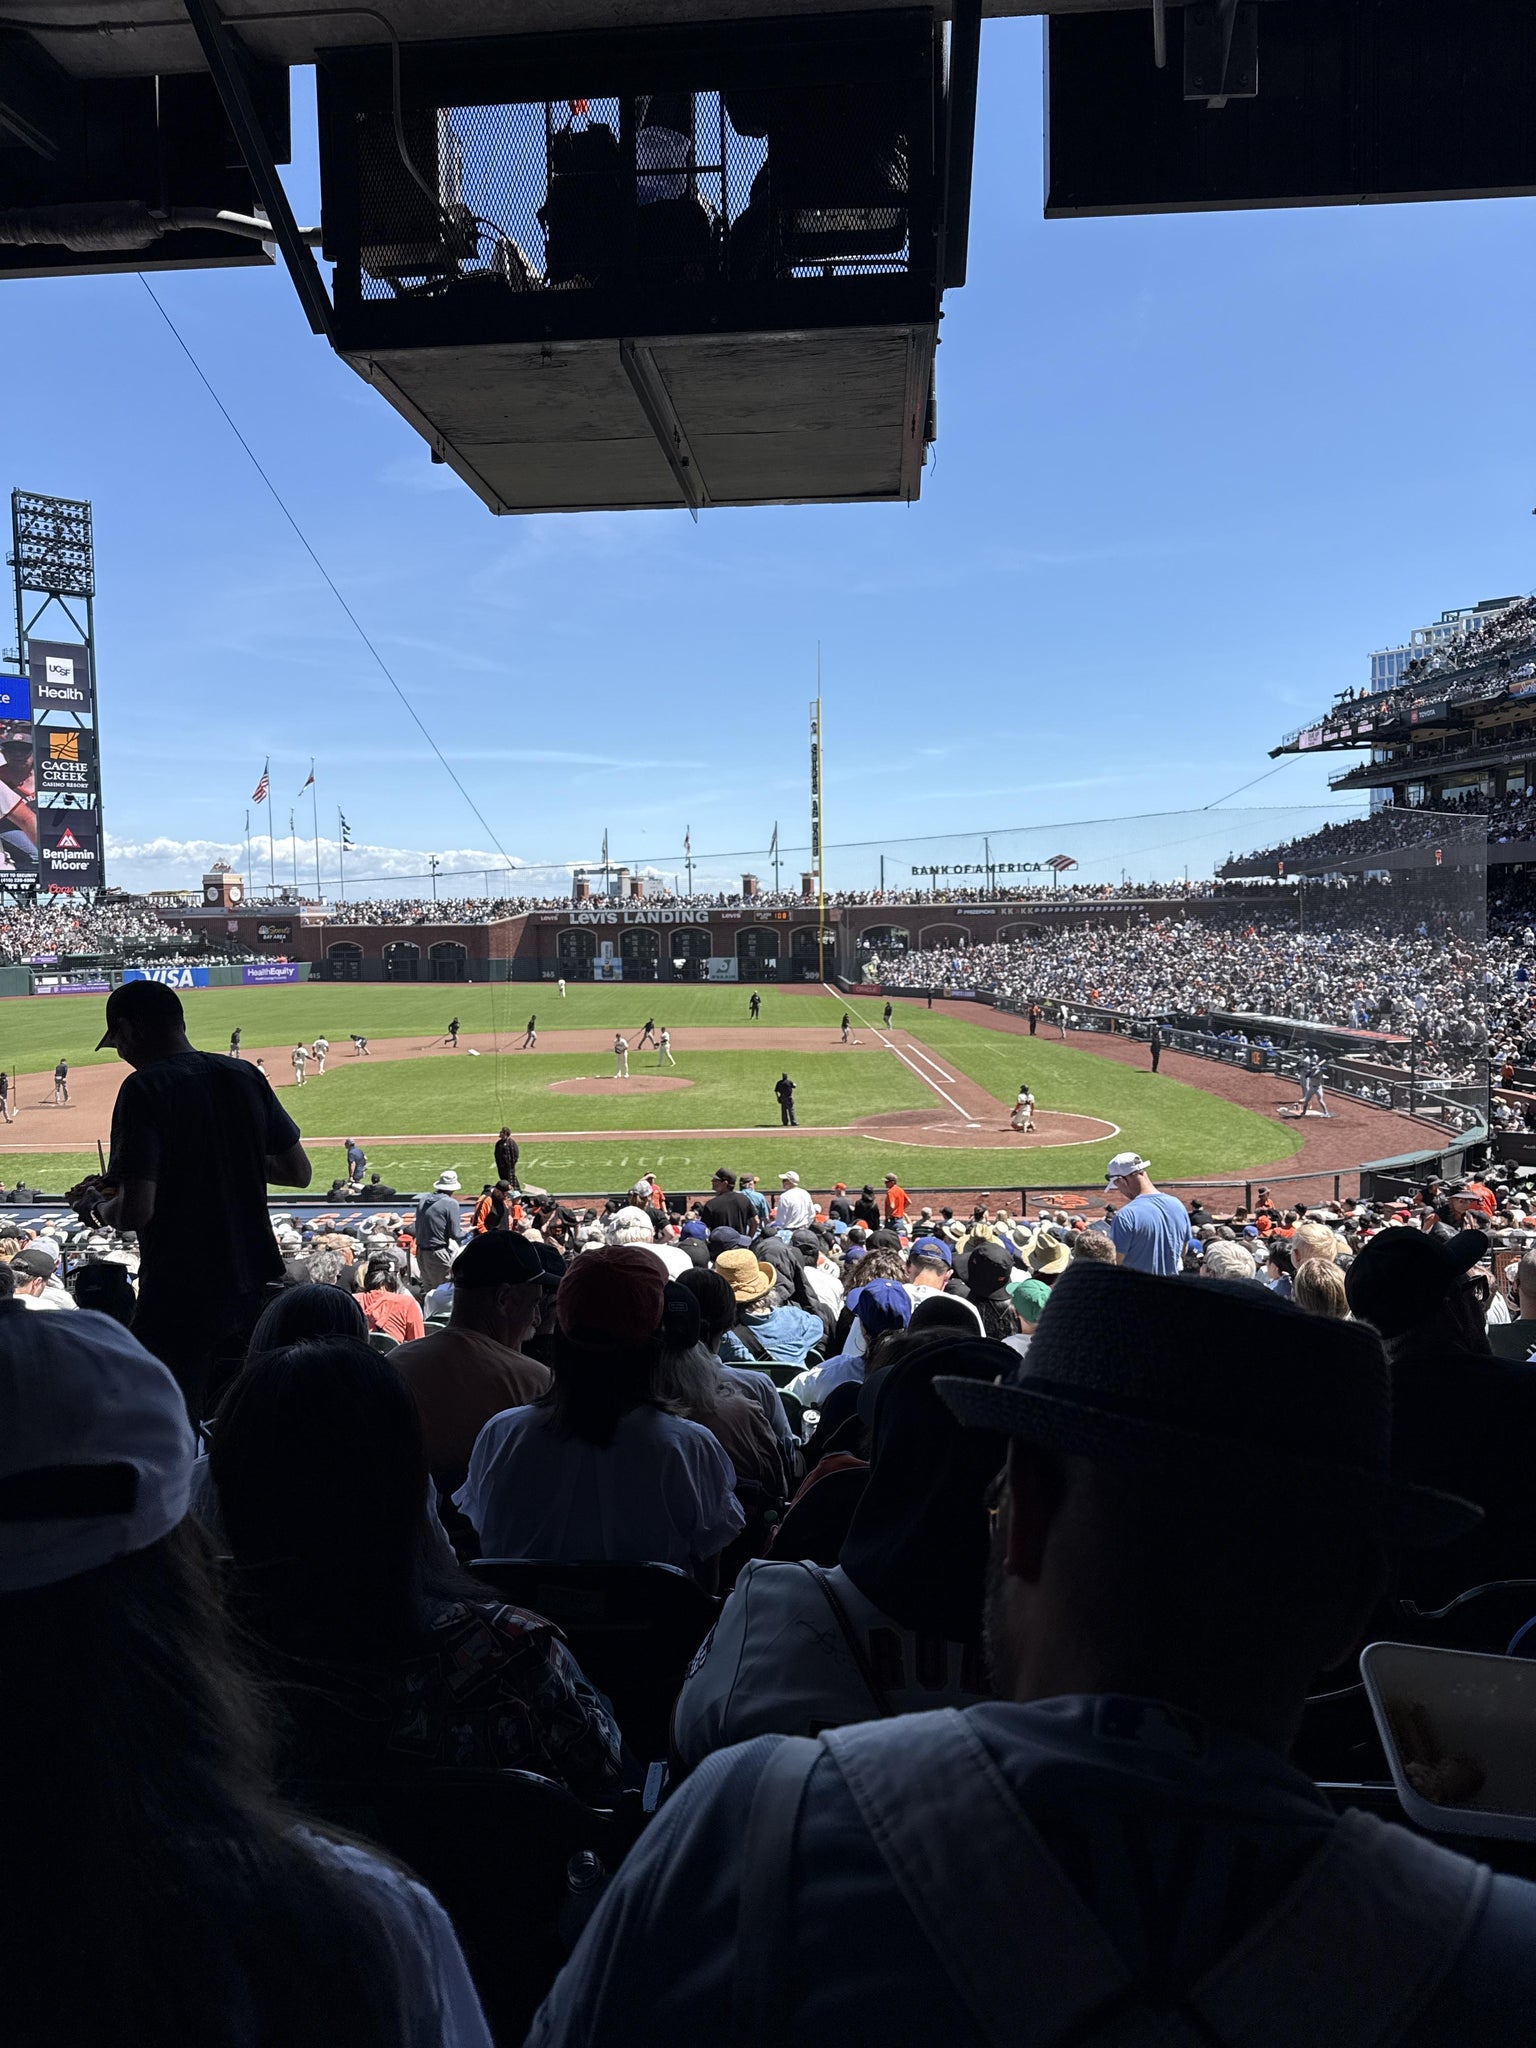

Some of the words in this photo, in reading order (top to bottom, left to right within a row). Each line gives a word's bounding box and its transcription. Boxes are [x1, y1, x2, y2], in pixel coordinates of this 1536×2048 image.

[49, 665, 71, 676] UCSF
[38, 685, 84, 701] Health
[1418, 709, 1436, 718] TOYOTA
[41, 761, 88, 772] CACHE
[43, 771, 87, 782] CREEK
[42, 848, 95, 861] Benjamin
[51, 860, 88, 870] Moore
[912, 865, 949, 875] BANK
[954, 865, 971, 874] OF
[975, 862, 1041, 873] AMERICA
[623, 911, 709, 924] LANDING
[247, 967, 295, 977] HealthEquity
[542, 970, 555, 978] 365
[804, 971, 819, 979] 309
[140, 969, 194, 988] VISA
